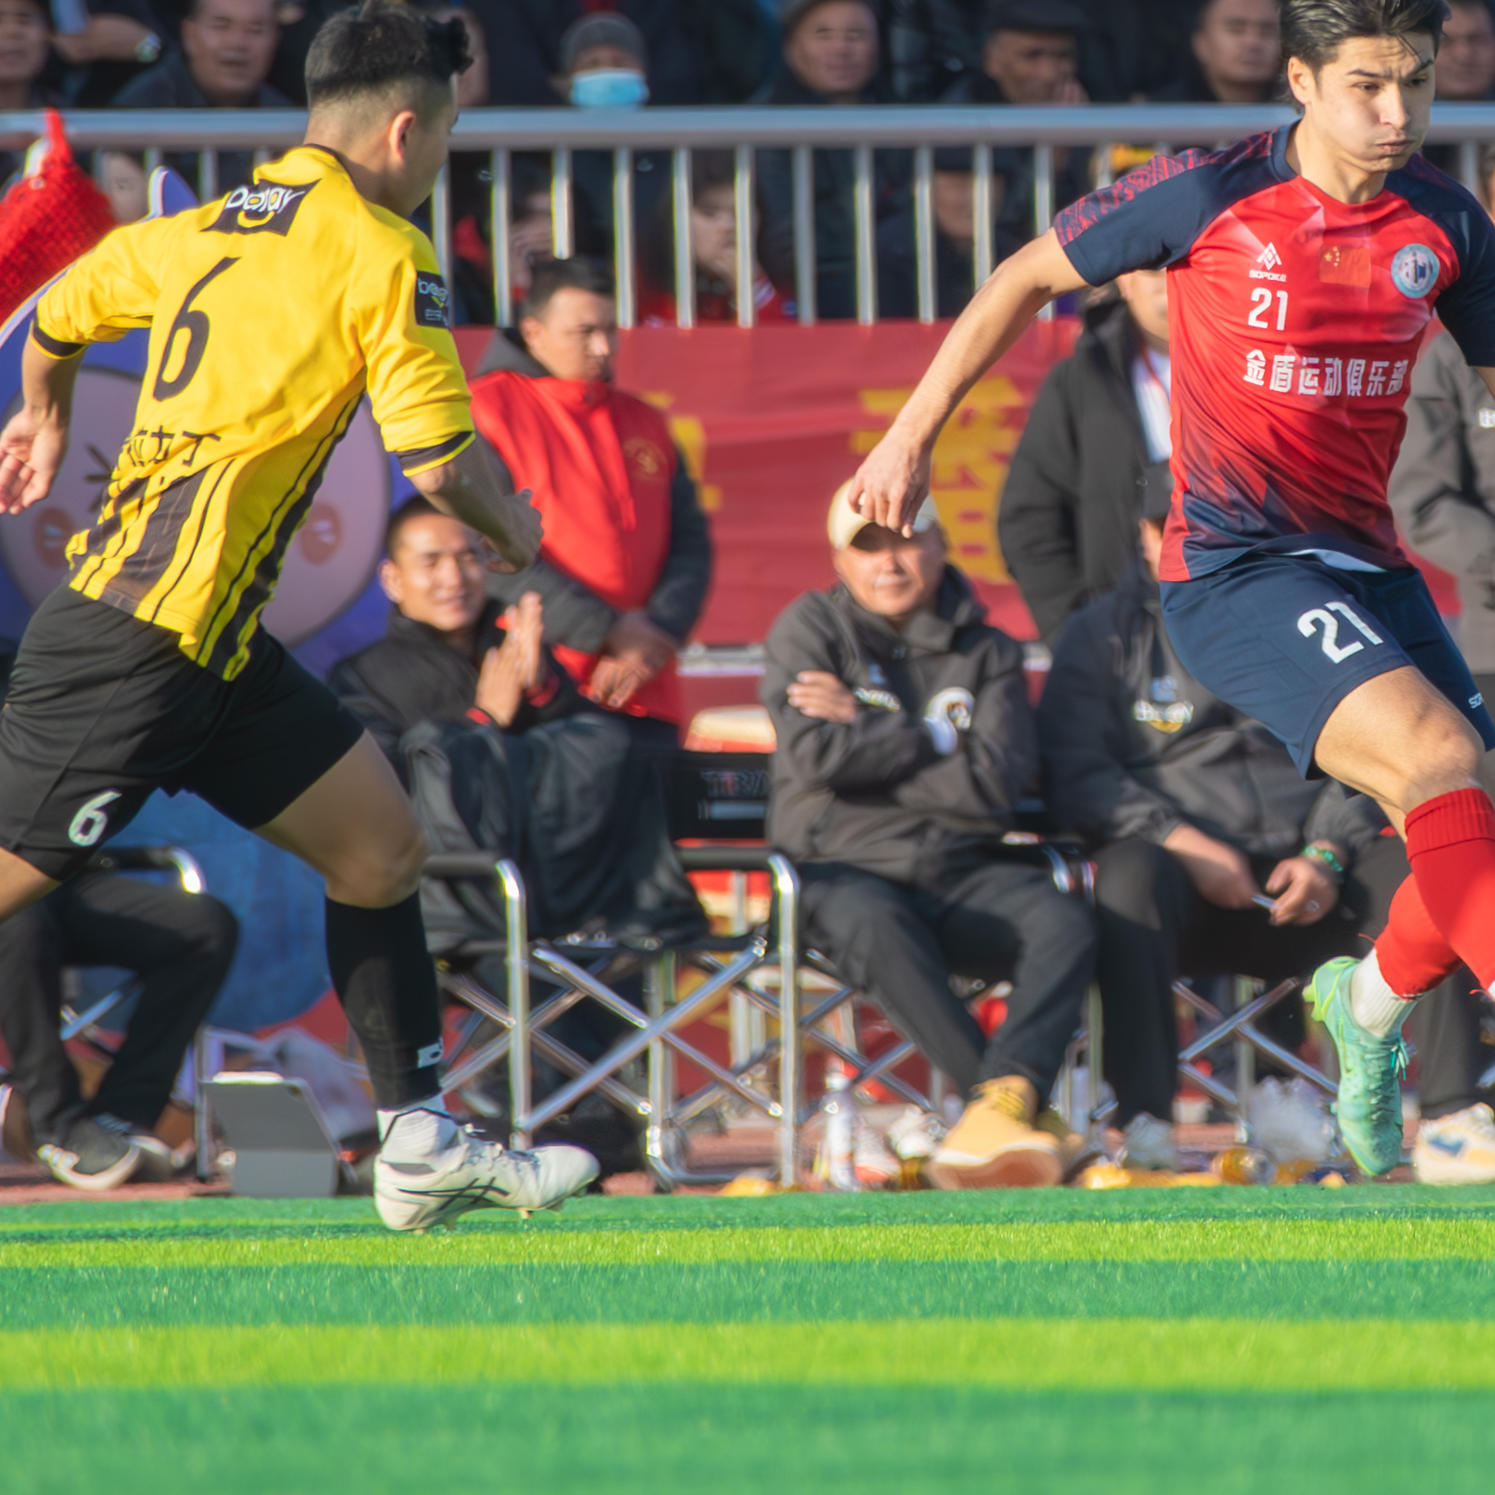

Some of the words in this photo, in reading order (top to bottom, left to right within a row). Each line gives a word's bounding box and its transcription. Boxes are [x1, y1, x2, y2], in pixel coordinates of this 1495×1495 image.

[153, 256, 241, 402] 6
[1247, 287, 1288, 331] 21
[1243, 349, 1408, 397] 金盾运动俱乐部
[1297, 601, 1383, 664] 21
[68, 791, 122, 847] 6
